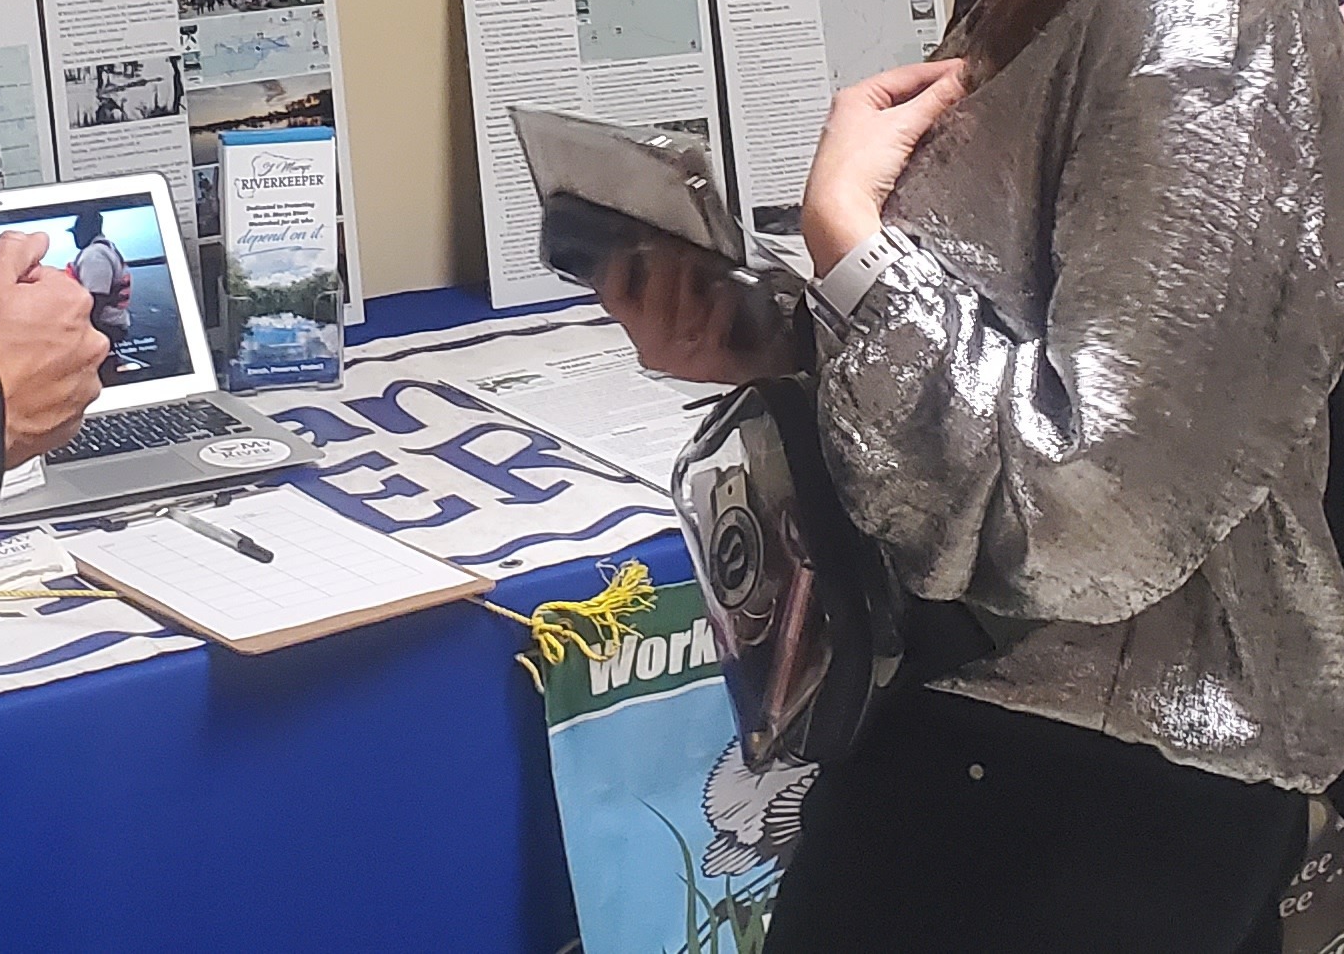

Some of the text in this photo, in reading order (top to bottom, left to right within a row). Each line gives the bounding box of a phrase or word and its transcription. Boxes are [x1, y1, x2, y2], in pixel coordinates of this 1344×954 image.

[241, 174, 325, 190] RIVERKEEPER
[237, 223, 324, 252] depend on it.
[221, 447, 271, 458] RIVER
[589, 617, 719, 695] Work
